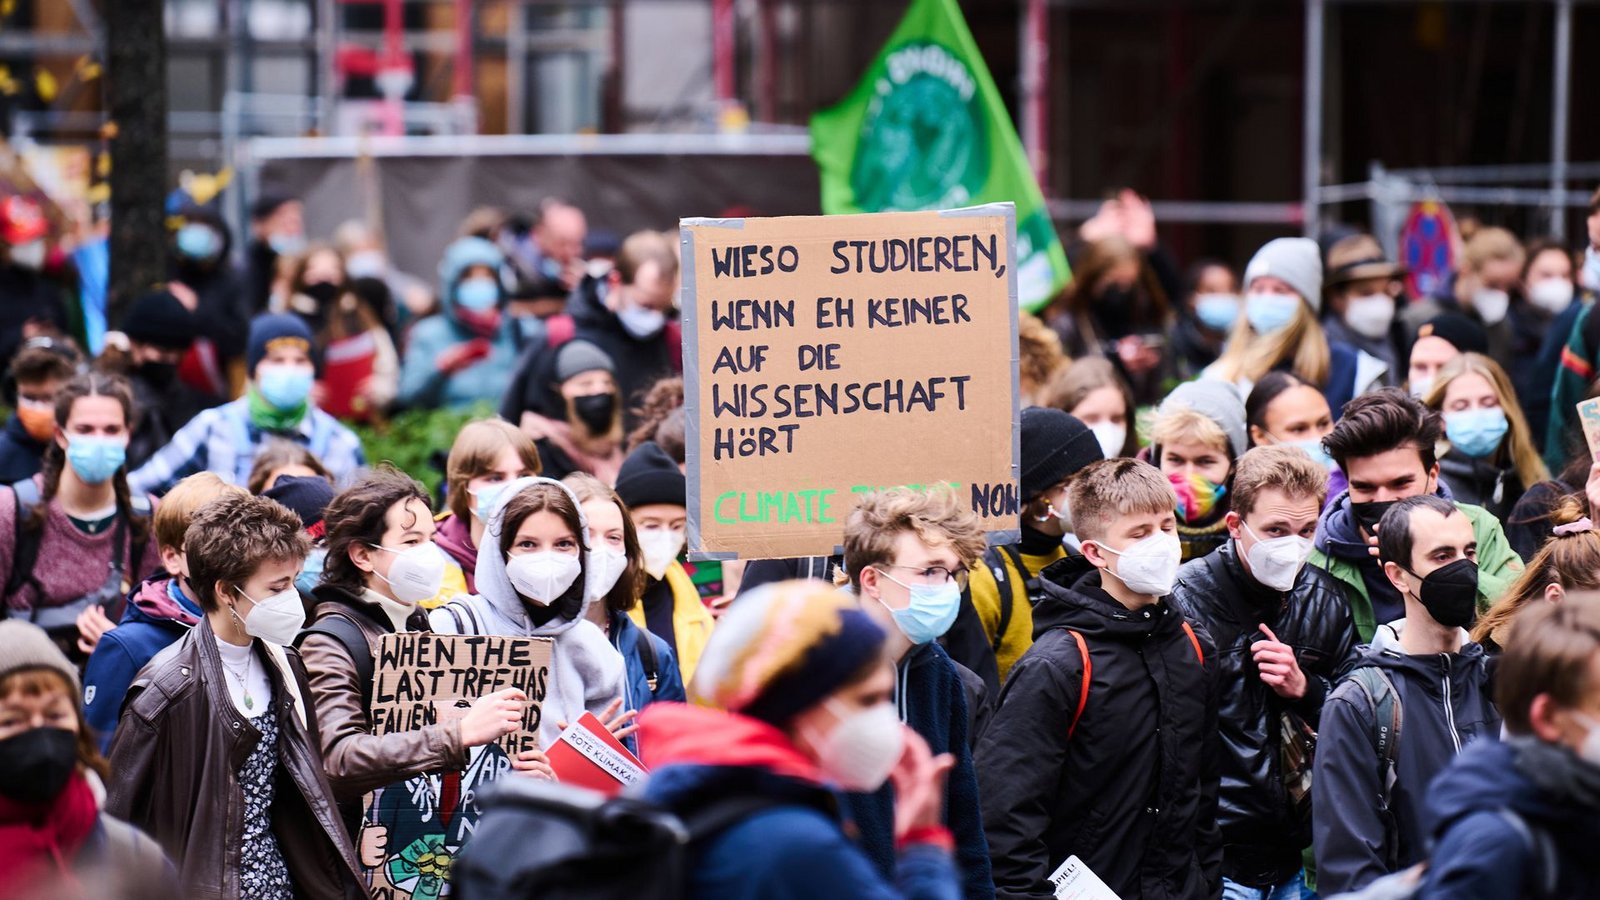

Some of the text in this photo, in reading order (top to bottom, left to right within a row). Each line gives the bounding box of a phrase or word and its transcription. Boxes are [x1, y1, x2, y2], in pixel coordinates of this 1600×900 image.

[711, 234, 1007, 279] WIESO STUDIEREN,
[711, 294, 971, 331] WENN EH KEINER
[712, 343, 841, 374] AUF DIE
[712, 375, 971, 418] WISSENSCHAFT
[714, 489, 837, 525] CLIMATE
[380, 636, 531, 670] WHEN THE
[377, 669, 445, 704] LAST
[569, 732, 594, 753] ROTE
